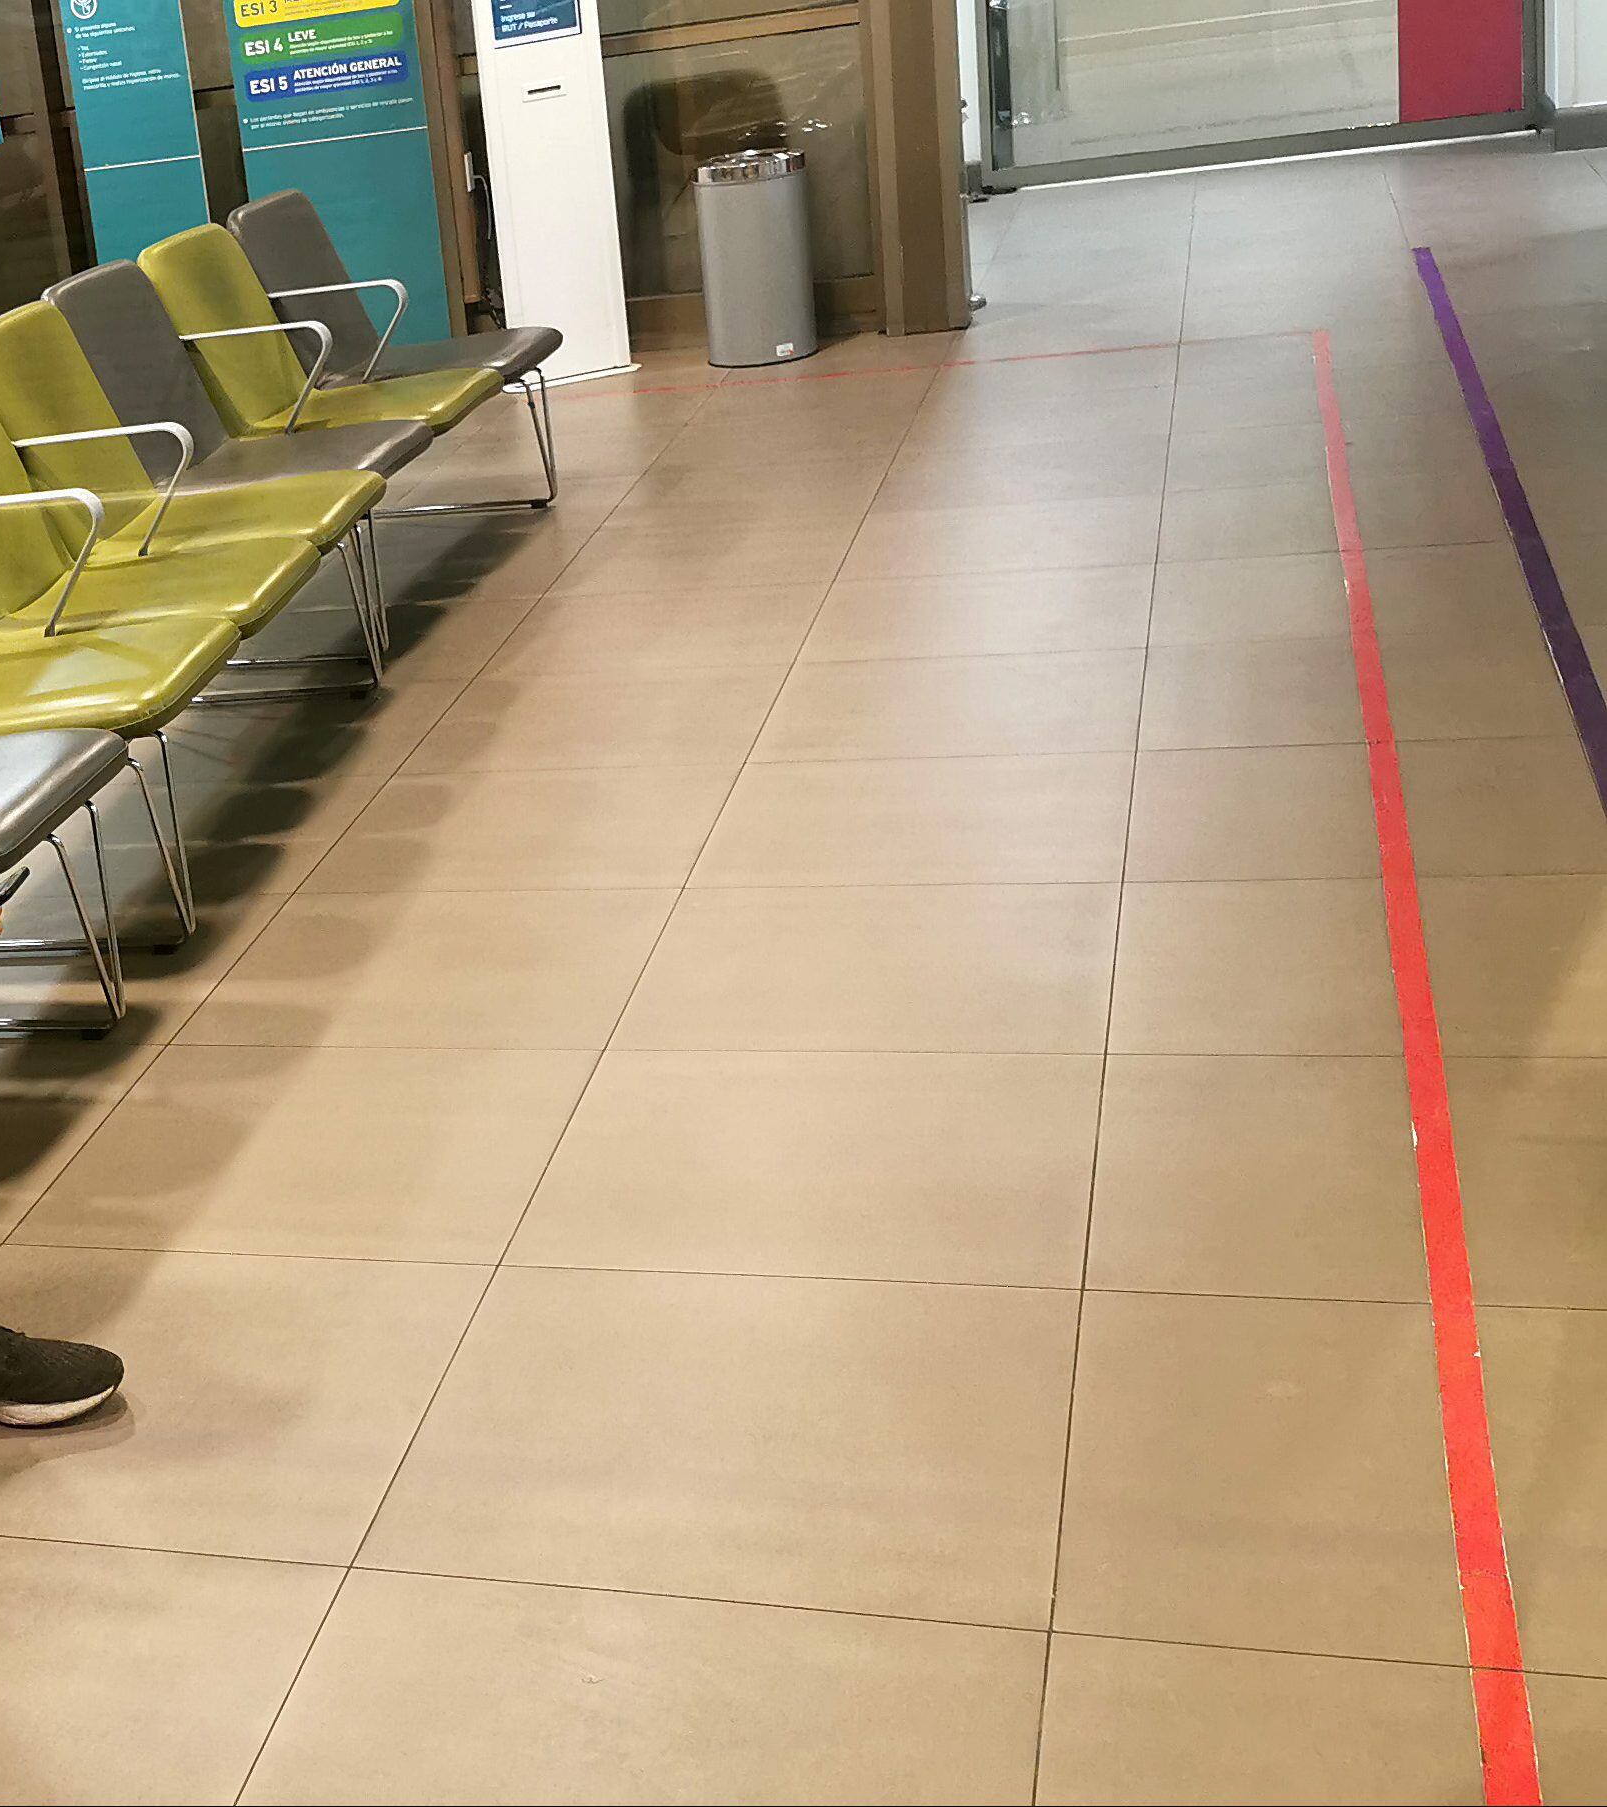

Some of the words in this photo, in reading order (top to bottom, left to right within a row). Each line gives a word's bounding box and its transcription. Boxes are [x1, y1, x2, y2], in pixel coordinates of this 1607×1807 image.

[241, 2, 265, 17] ESI
[269, 0, 278, 13] 3
[288, 29, 317, 42] LEVE
[244, 40, 270, 56] ESI
[273, 37, 284, 52] 4
[293, 62, 348, 80] ATENCIÓN
[349, 56, 402, 73] GENERAL
[249, 77, 275, 95] ESI
[278, 74, 289, 91] 5
